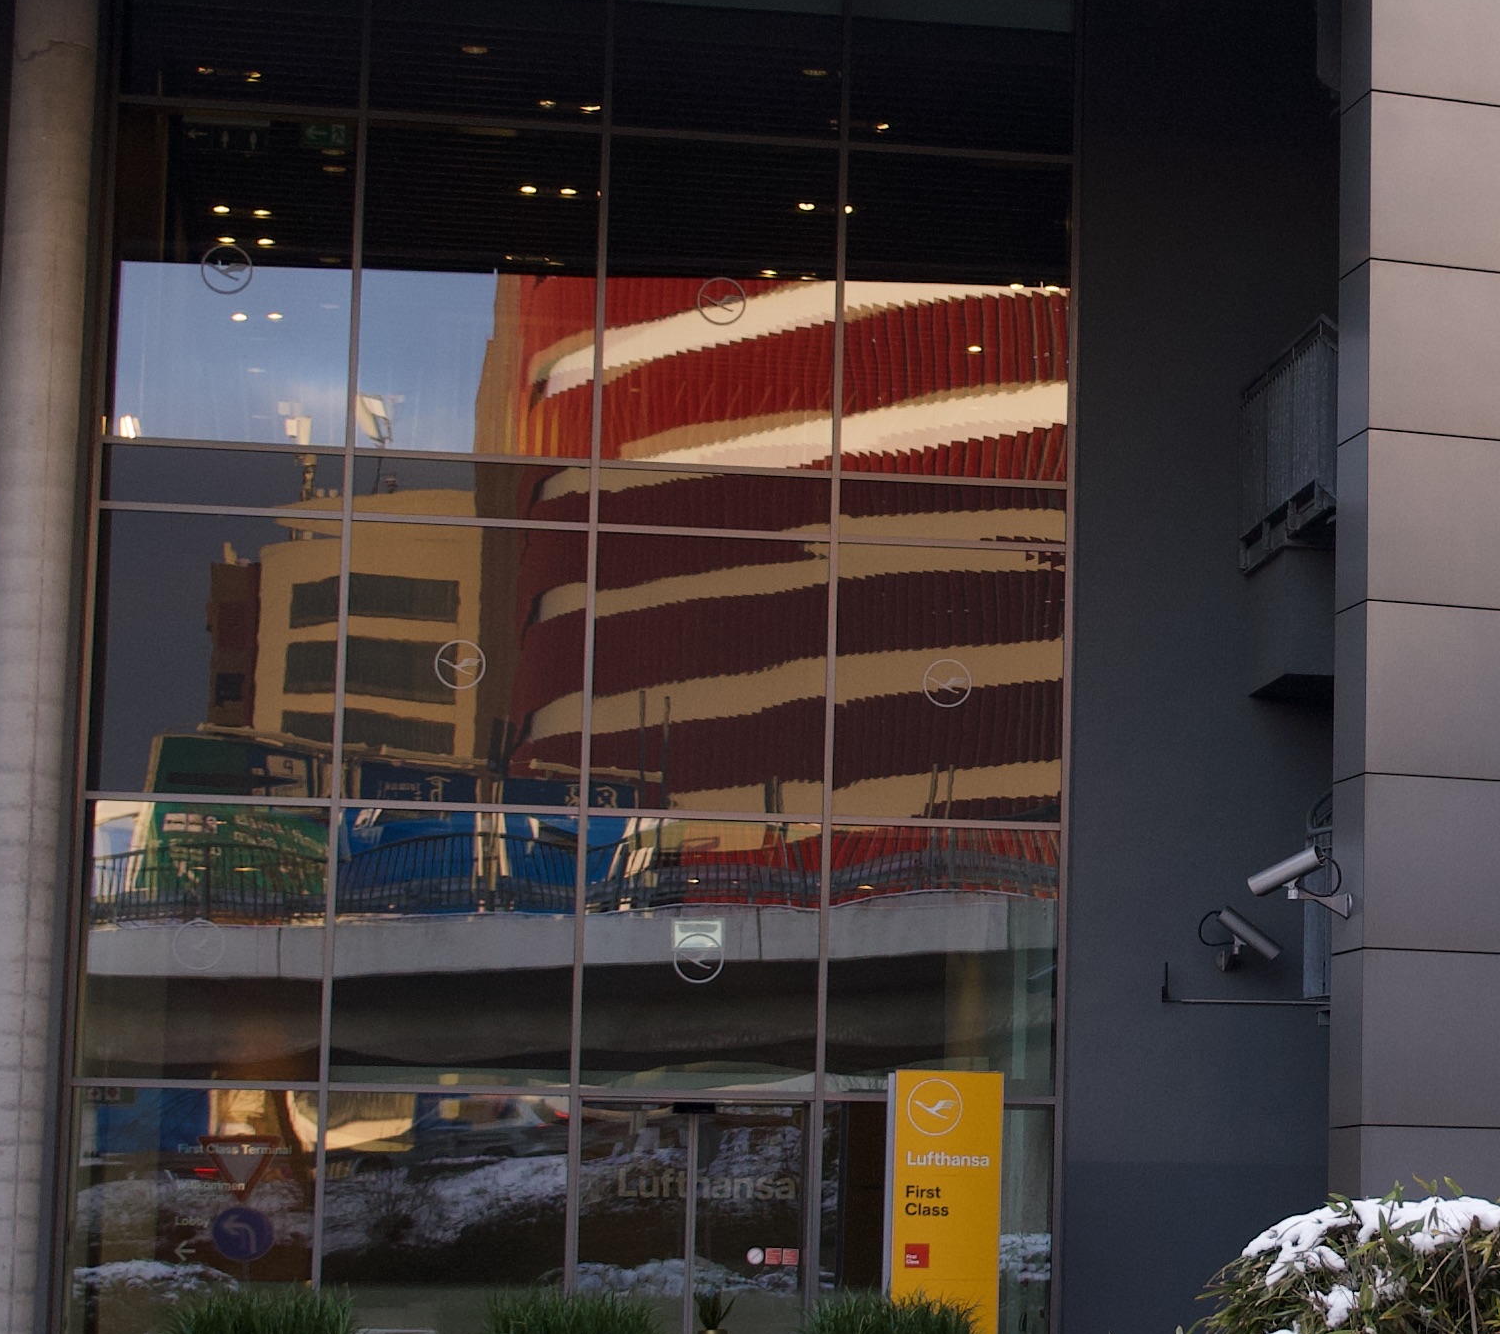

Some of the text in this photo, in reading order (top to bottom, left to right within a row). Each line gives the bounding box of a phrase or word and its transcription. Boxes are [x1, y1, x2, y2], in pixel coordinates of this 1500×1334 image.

[177, 1143, 292, 1155] First Class Terminal
[907, 1151, 990, 1167] Lufthansa
[905, 1185, 941, 1199] First
[905, 1202, 949, 1217] Class
[174, 1216, 211, 1228] Lobby
